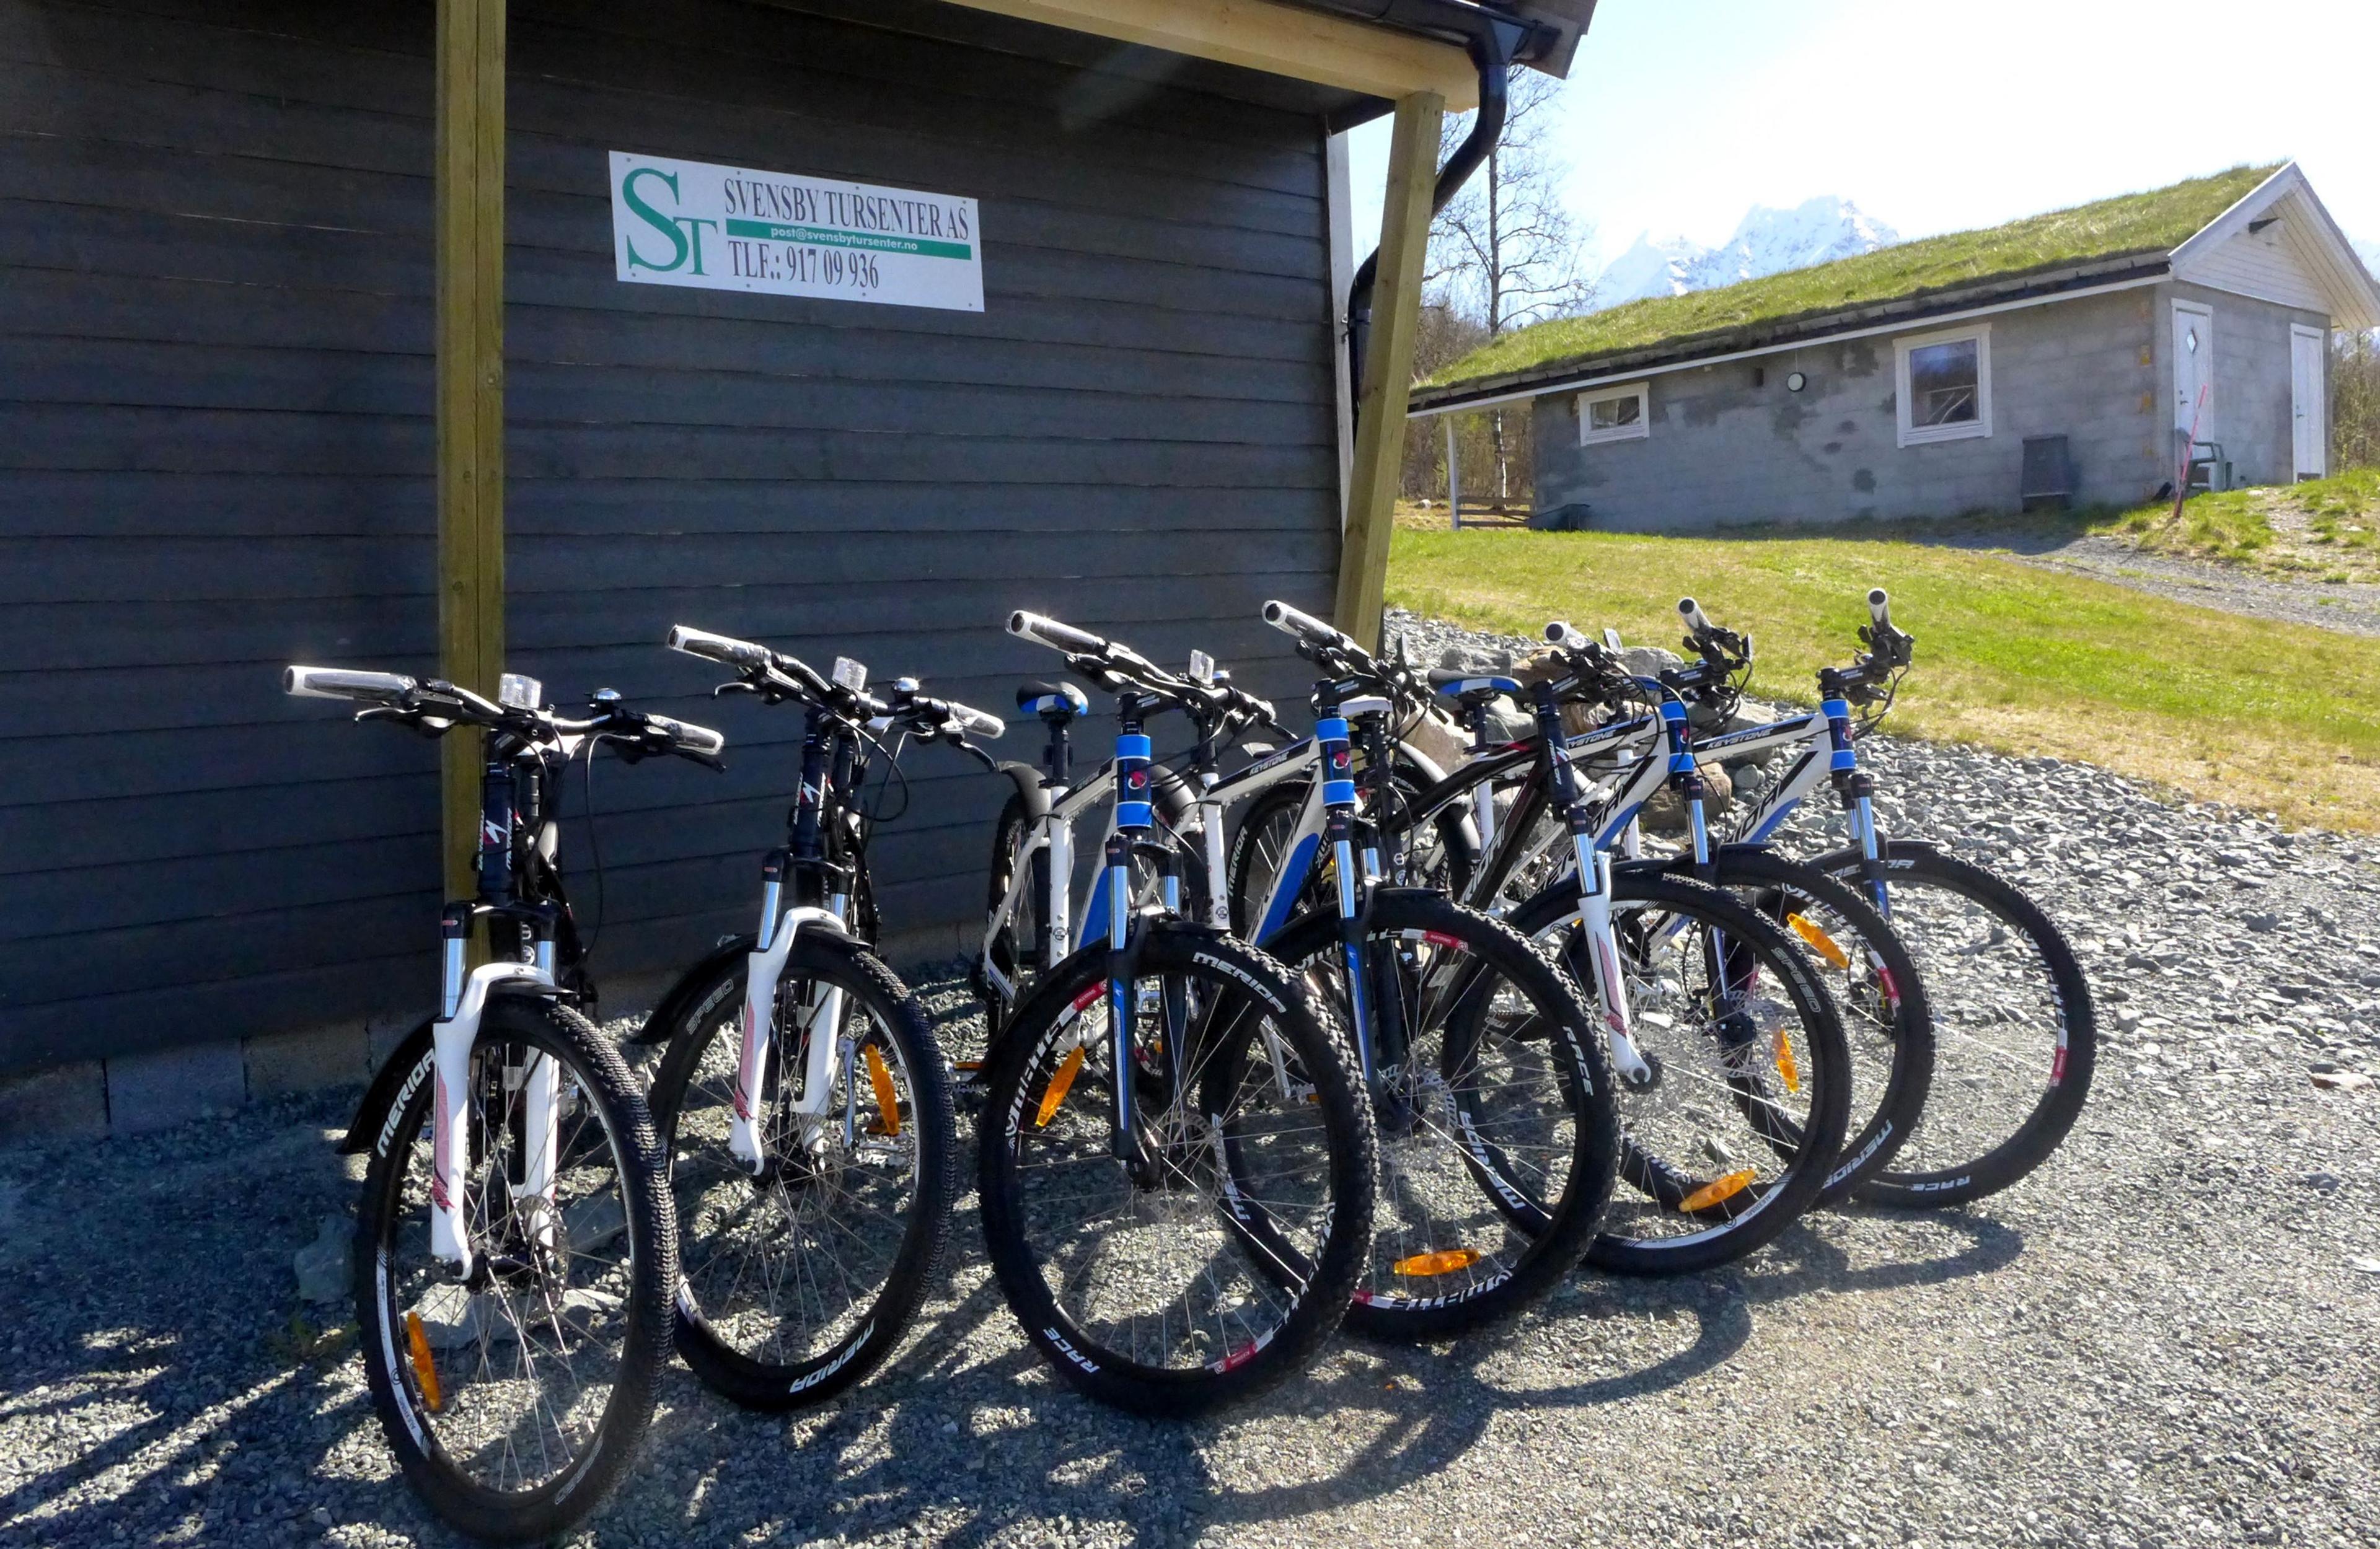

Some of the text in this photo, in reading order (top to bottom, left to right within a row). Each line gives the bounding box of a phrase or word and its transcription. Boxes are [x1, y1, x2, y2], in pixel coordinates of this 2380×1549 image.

[724, 178, 969, 240] SVENSBY TURSENTER AS
[770, 227, 918, 252] post@svensbytursenter.no
[787, 245, 817, 283] 917
[823, 249, 844, 285] 09
[848, 252, 879, 289] 936
[1706, 729, 1773, 750] KEYSTONE
[1227, 825, 1248, 897] MERIDA
[686, 979, 734, 1035] SPEED
[1192, 952, 1287, 1014] MERIDA
[1770, 947, 1821, 1012] SPEED
[1562, 1026, 1594, 1097] RACE
[377, 1048, 436, 1158] MERIDA
[1459, 1110, 1527, 1209] MERIDA
[1821, 1119, 1893, 1190] MERIDA
[1911, 1175, 1971, 1191] RACE
[789, 1317, 876, 1393] MERIDA
[1043, 1327, 1100, 1374] RACE
